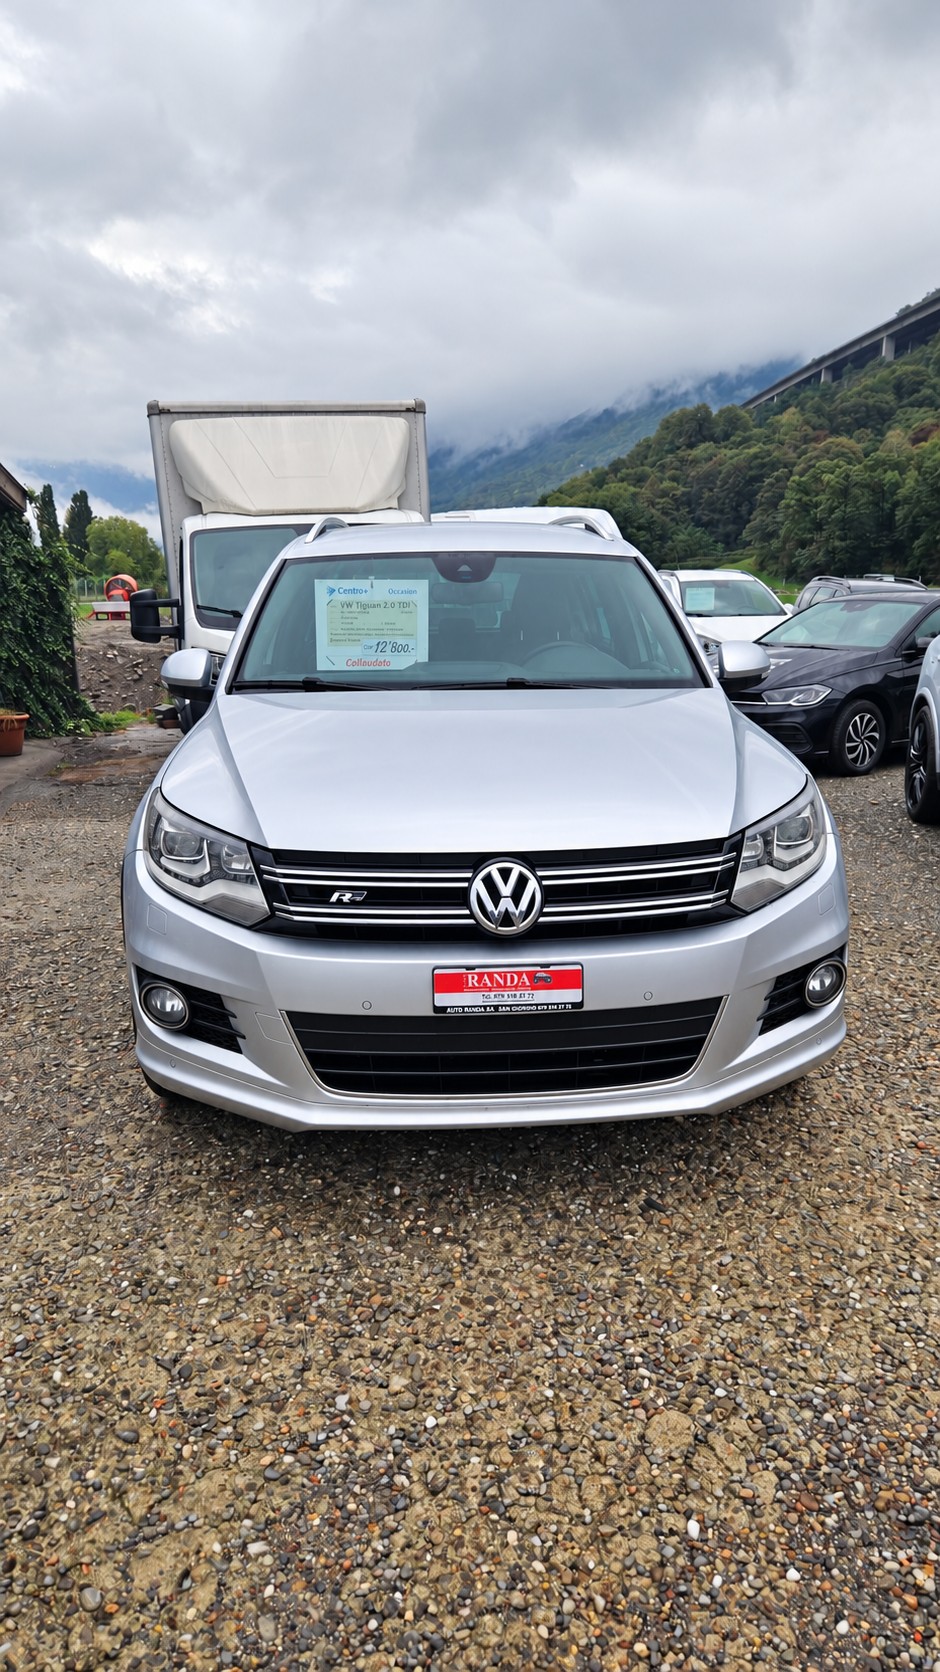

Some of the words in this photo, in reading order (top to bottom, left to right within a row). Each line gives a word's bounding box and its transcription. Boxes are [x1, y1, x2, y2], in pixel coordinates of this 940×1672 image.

[337, 586, 369, 595] Centro+
[340, 601, 354, 609] VW
[356, 601, 382, 610] Tiguan
[383, 601, 396, 609] 2.0
[397, 601, 411, 609] TDI
[375, 640, 415, 654] 12'800.-
[345, 657, 392, 667] Collaudato
[467, 972, 531, 988] RANDA
